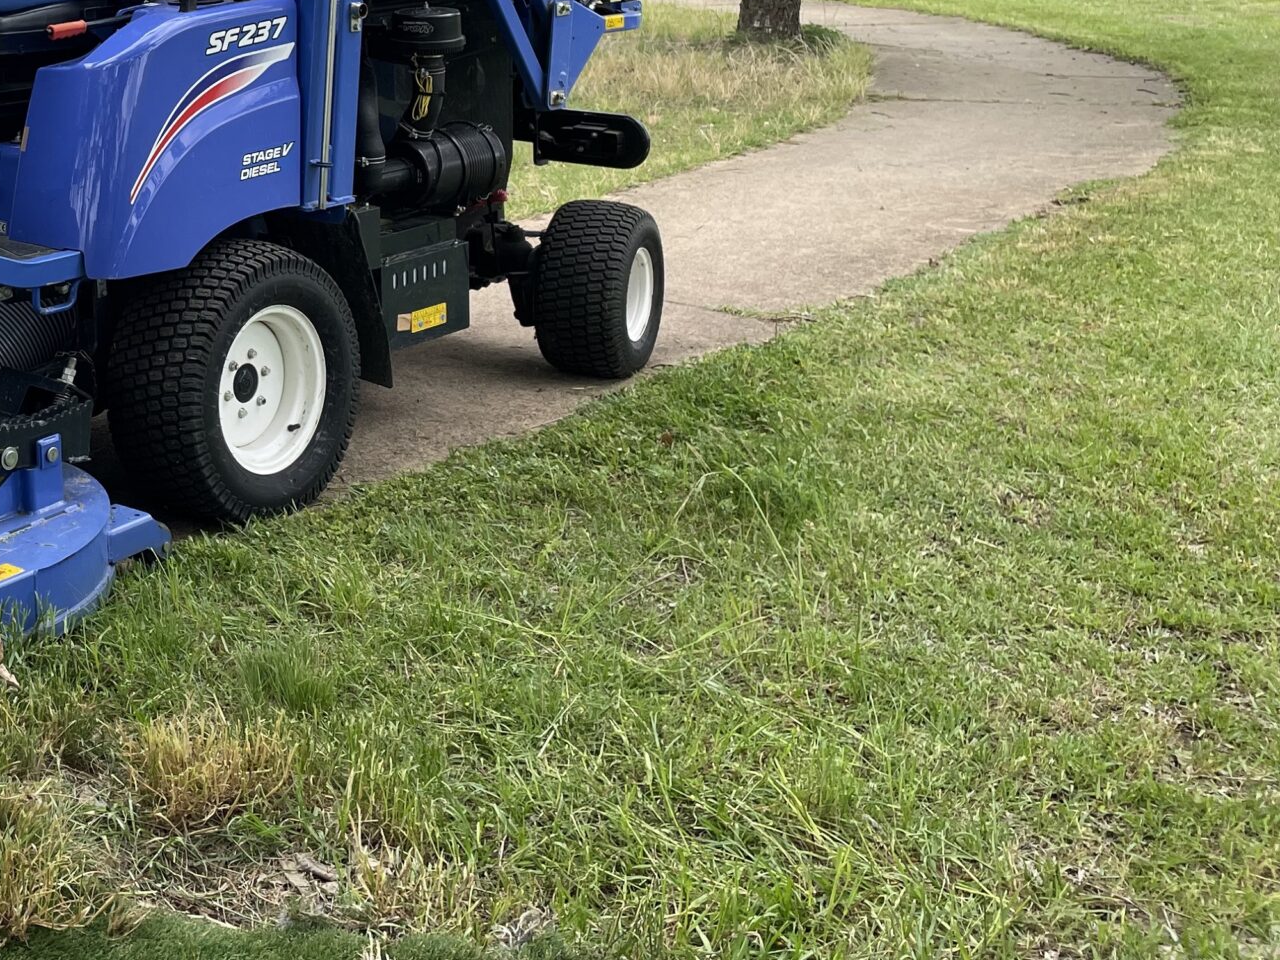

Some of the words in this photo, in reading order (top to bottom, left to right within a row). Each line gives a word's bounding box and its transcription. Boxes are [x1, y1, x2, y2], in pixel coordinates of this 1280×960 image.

[206, 16, 287, 55] SF237
[242, 146, 282, 166] STAGE
[240, 161, 281, 180] DIESEL
